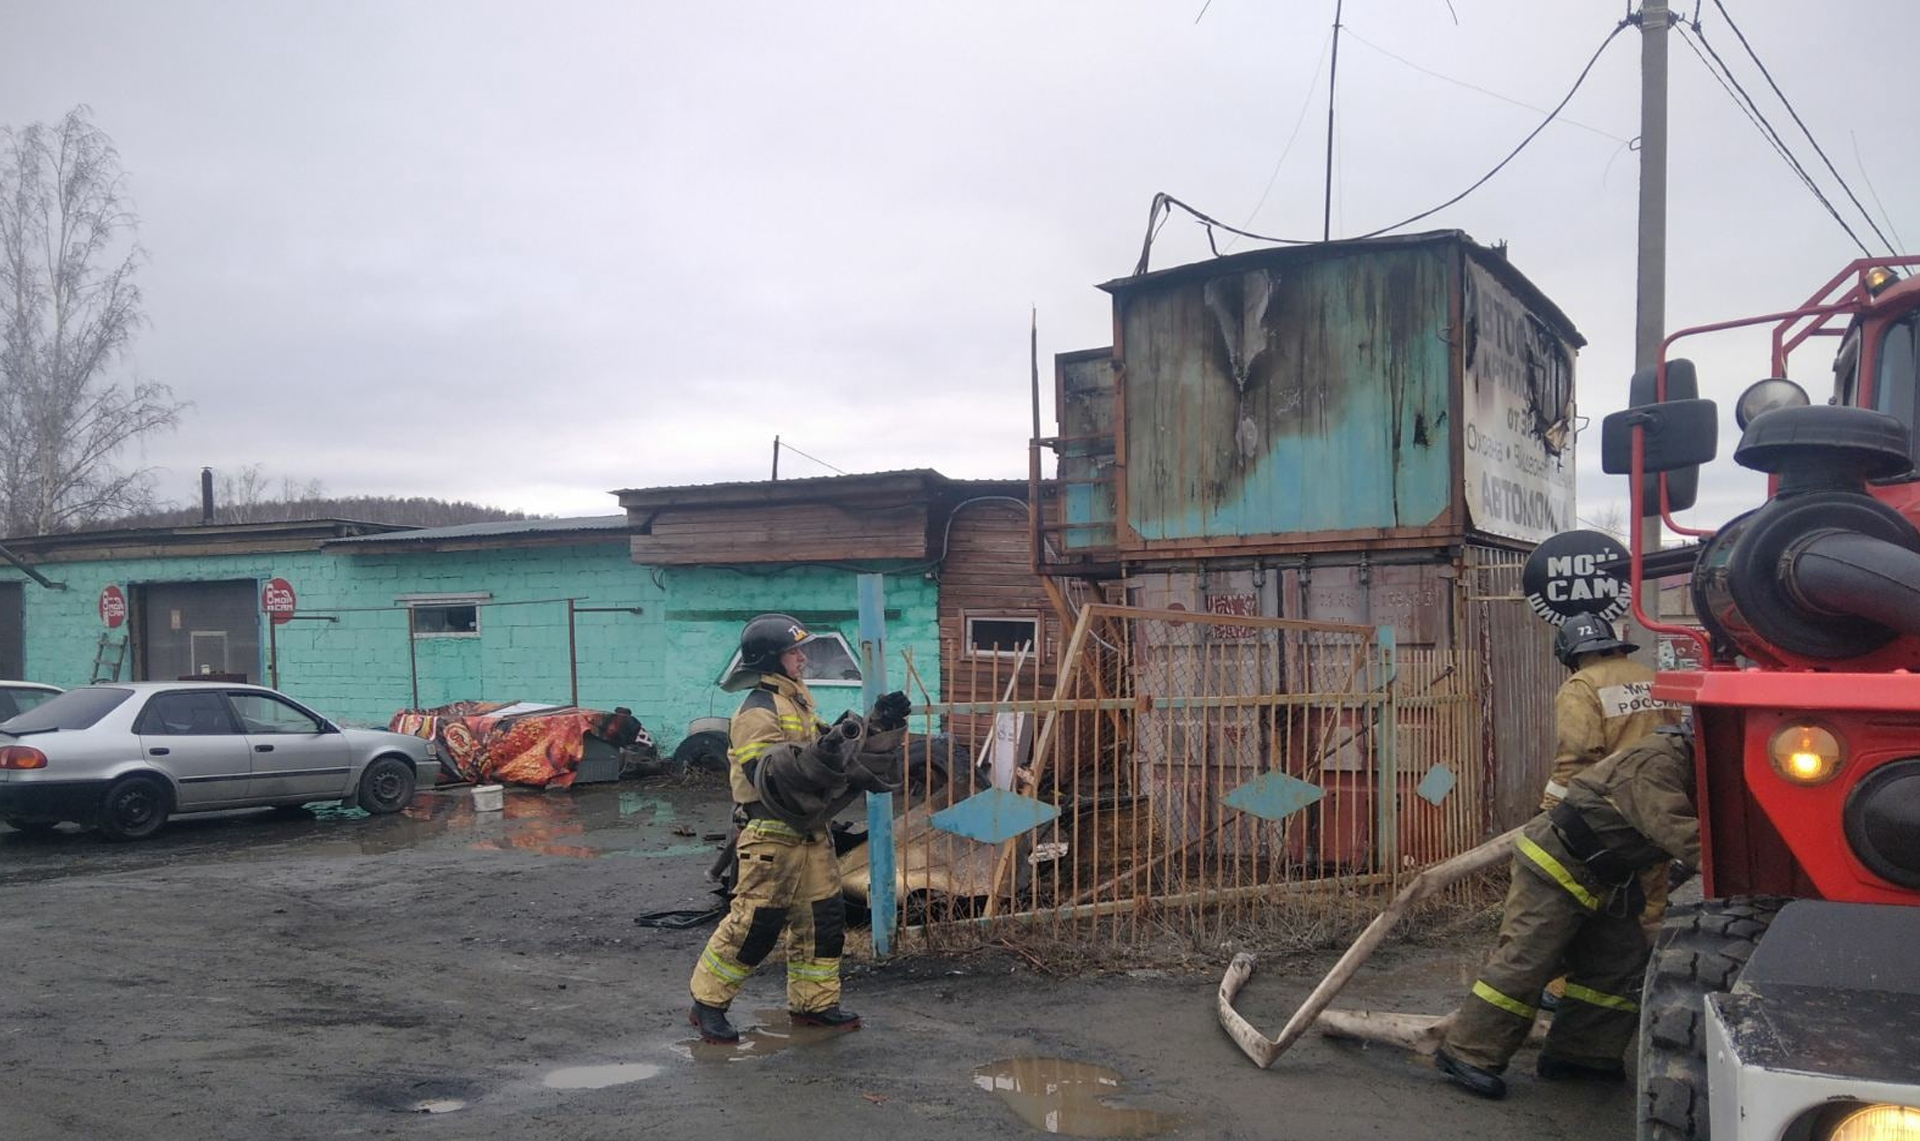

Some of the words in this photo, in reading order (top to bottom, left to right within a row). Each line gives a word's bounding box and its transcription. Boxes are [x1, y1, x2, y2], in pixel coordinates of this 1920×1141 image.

[1482, 471, 1571, 533] АВТОМОЙА
[1547, 577, 1619, 602] САМ
[1577, 626, 1594, 636] 72
